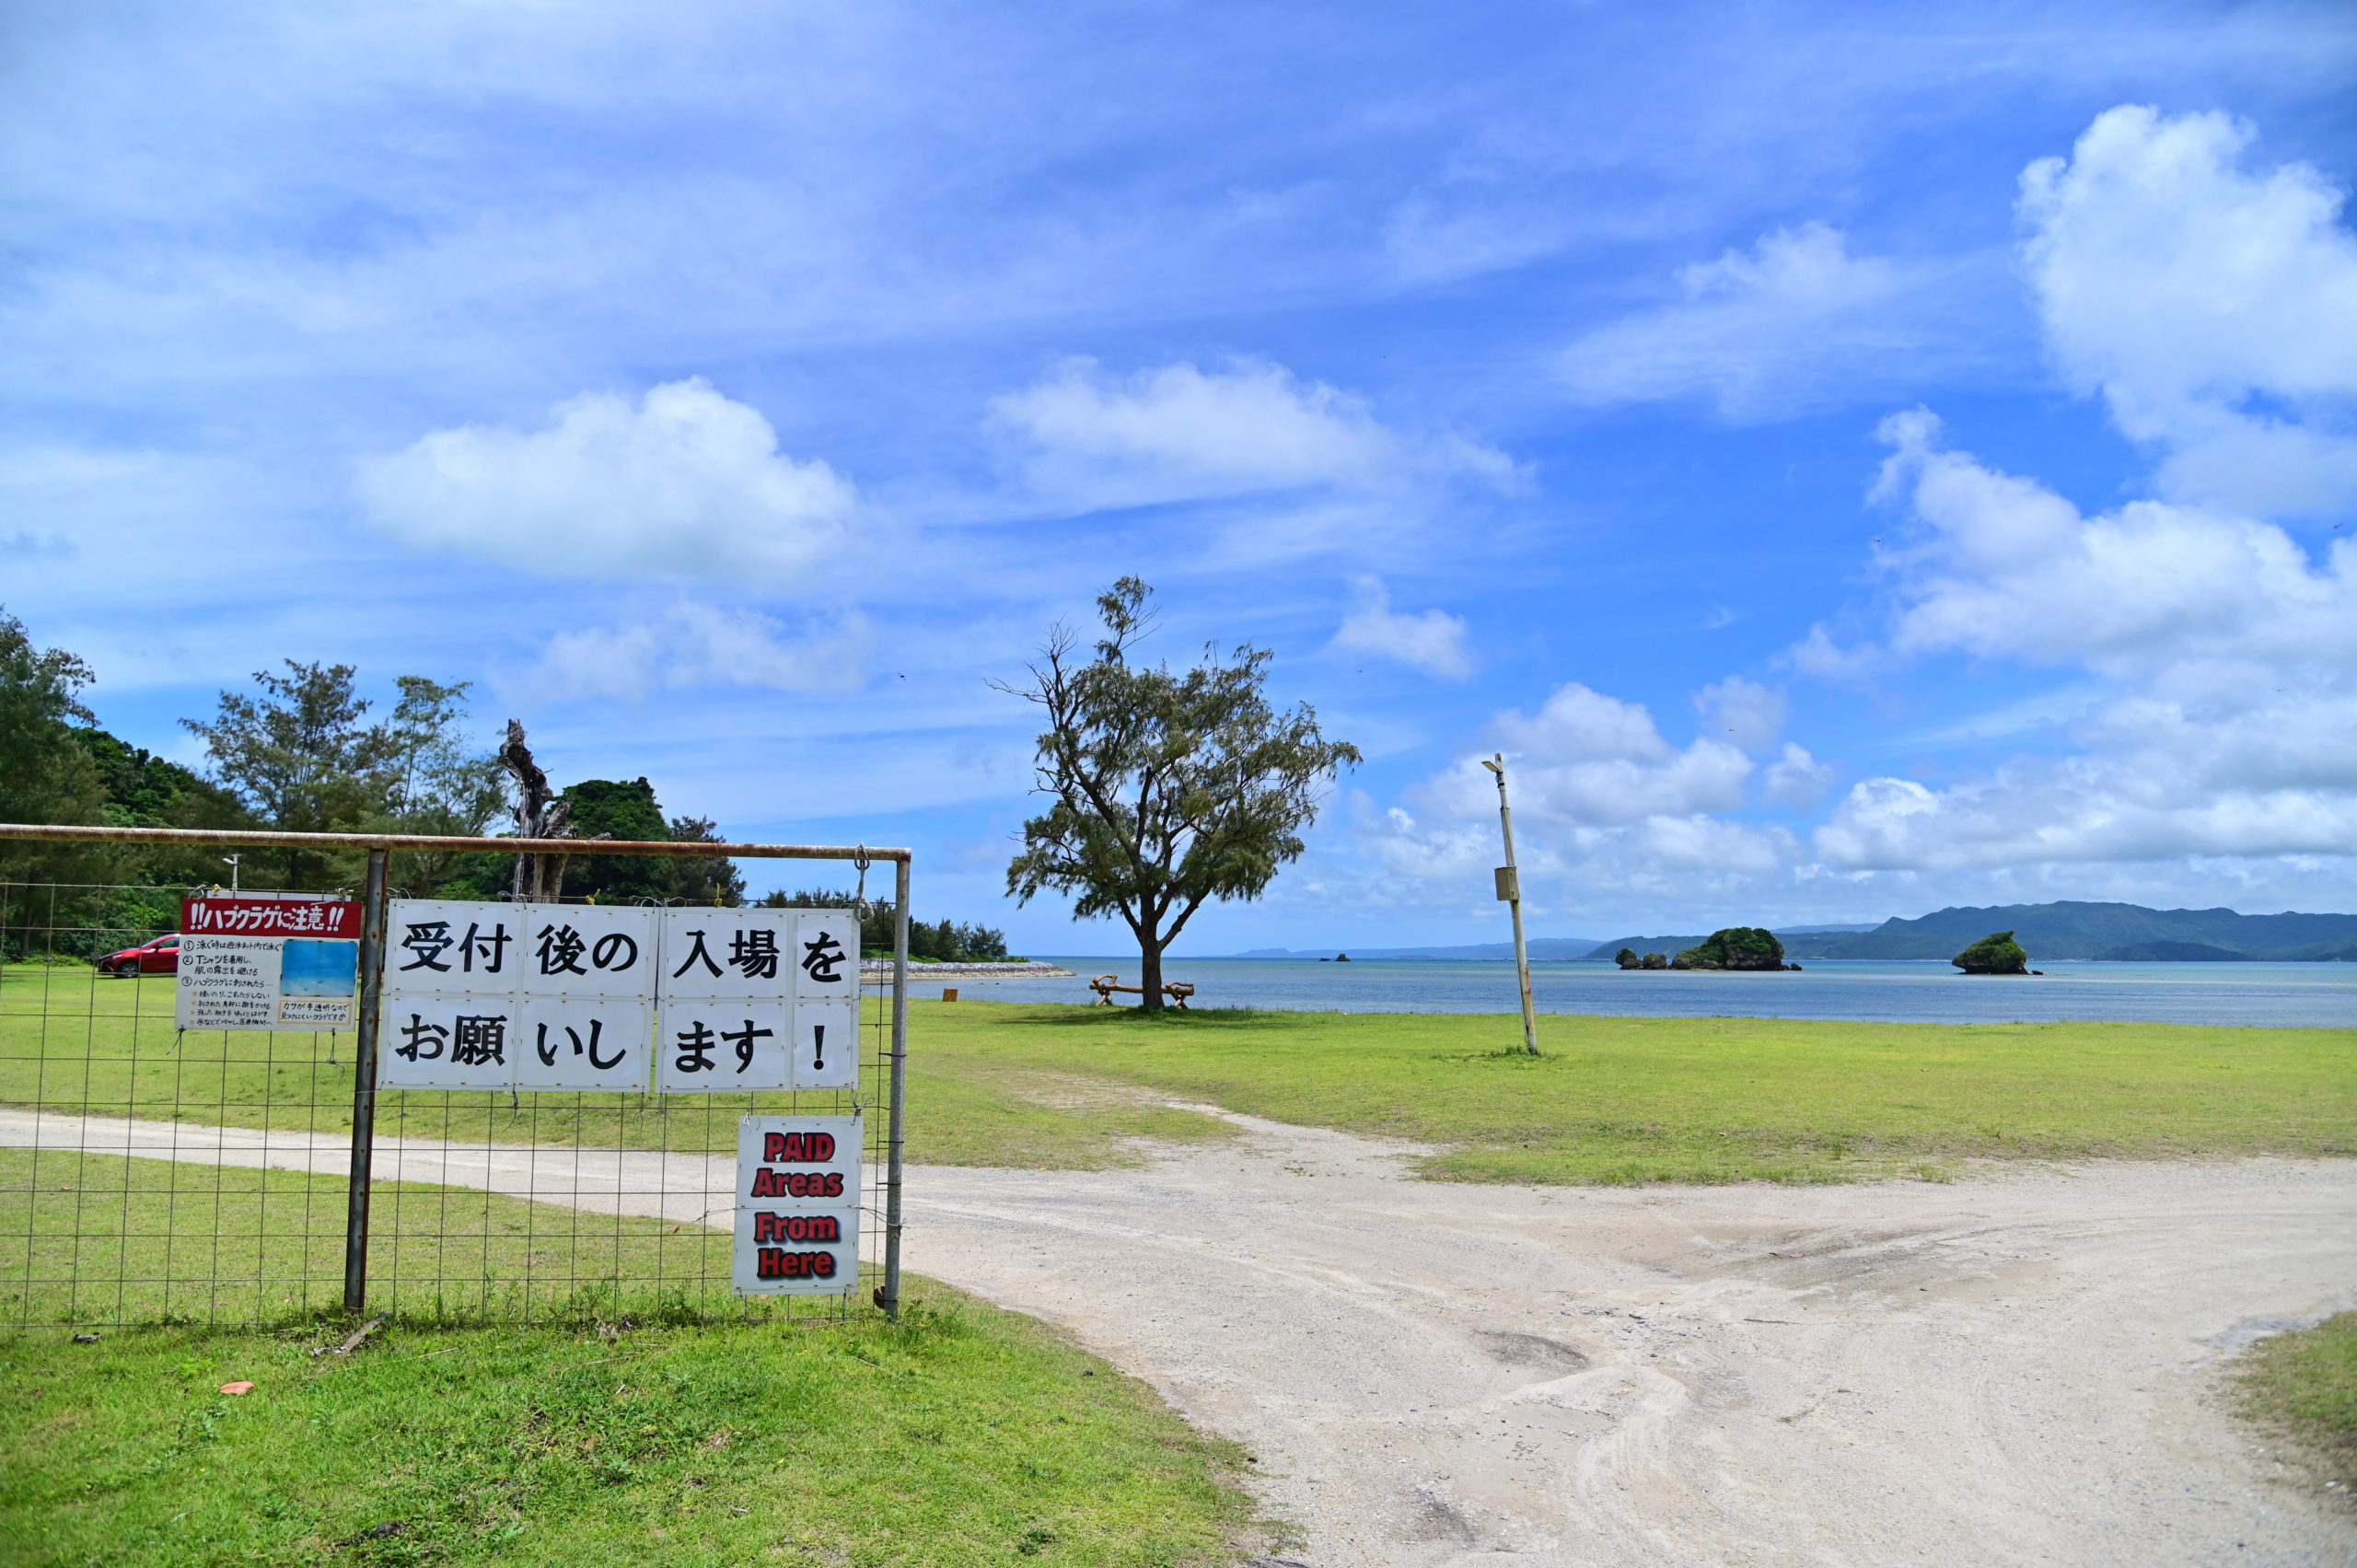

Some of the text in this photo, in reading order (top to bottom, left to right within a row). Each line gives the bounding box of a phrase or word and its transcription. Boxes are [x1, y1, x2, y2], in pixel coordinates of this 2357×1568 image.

[194, 965, 259, 976] 肌の露出を避ける
[763, 1132, 835, 1162] PAID
[750, 1167, 844, 1197] Areas
[754, 1212, 839, 1243] From
[757, 1248, 836, 1278] Here
